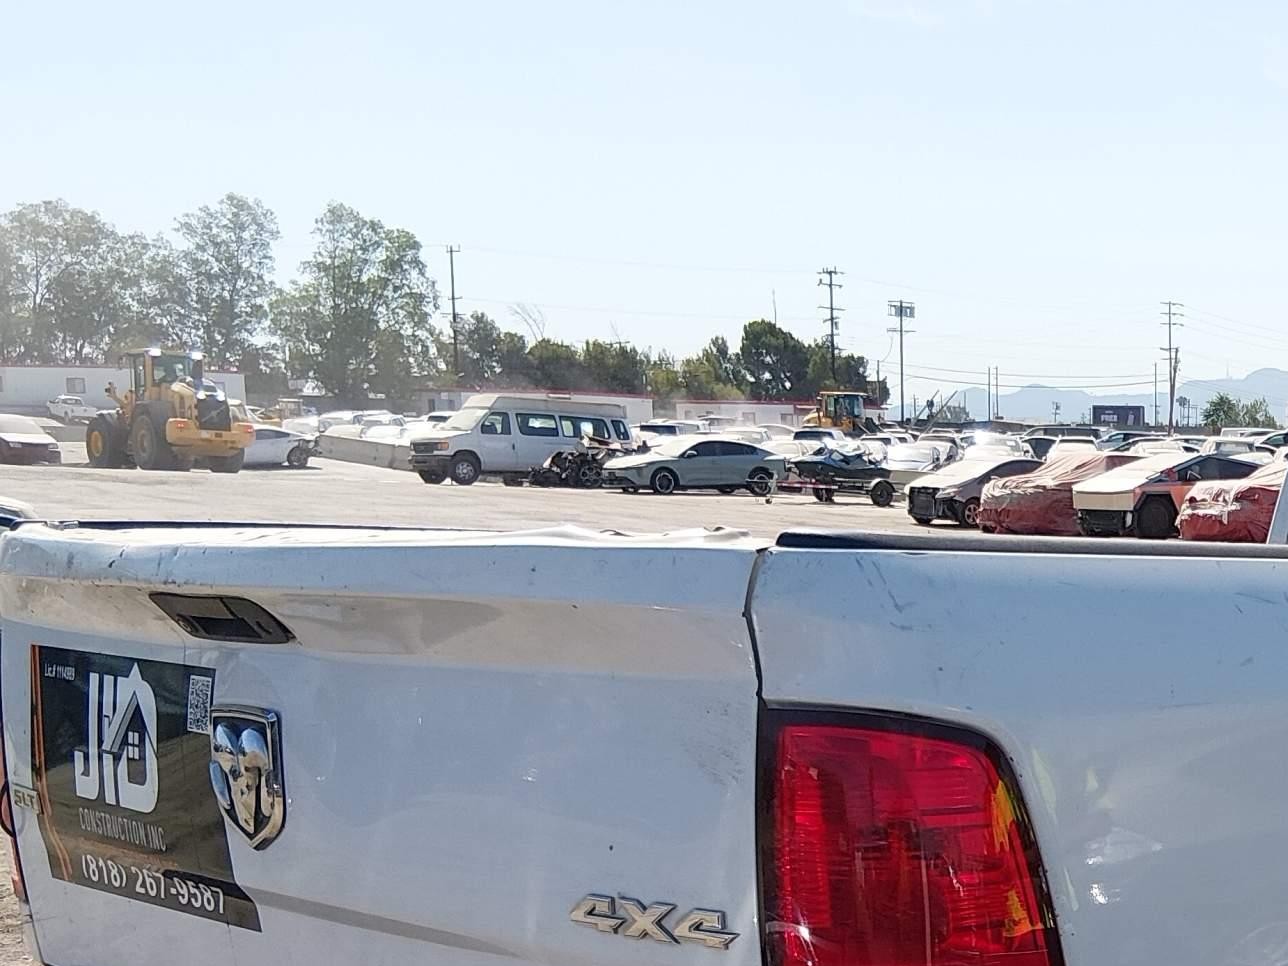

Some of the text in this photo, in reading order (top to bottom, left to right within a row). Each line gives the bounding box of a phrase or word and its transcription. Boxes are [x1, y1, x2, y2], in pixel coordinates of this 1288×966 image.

[14, 789, 35, 810] SLT
[79, 807, 168, 852] CONSTRUCTION INC
[82, 854, 225, 914] (818) 267-9587
